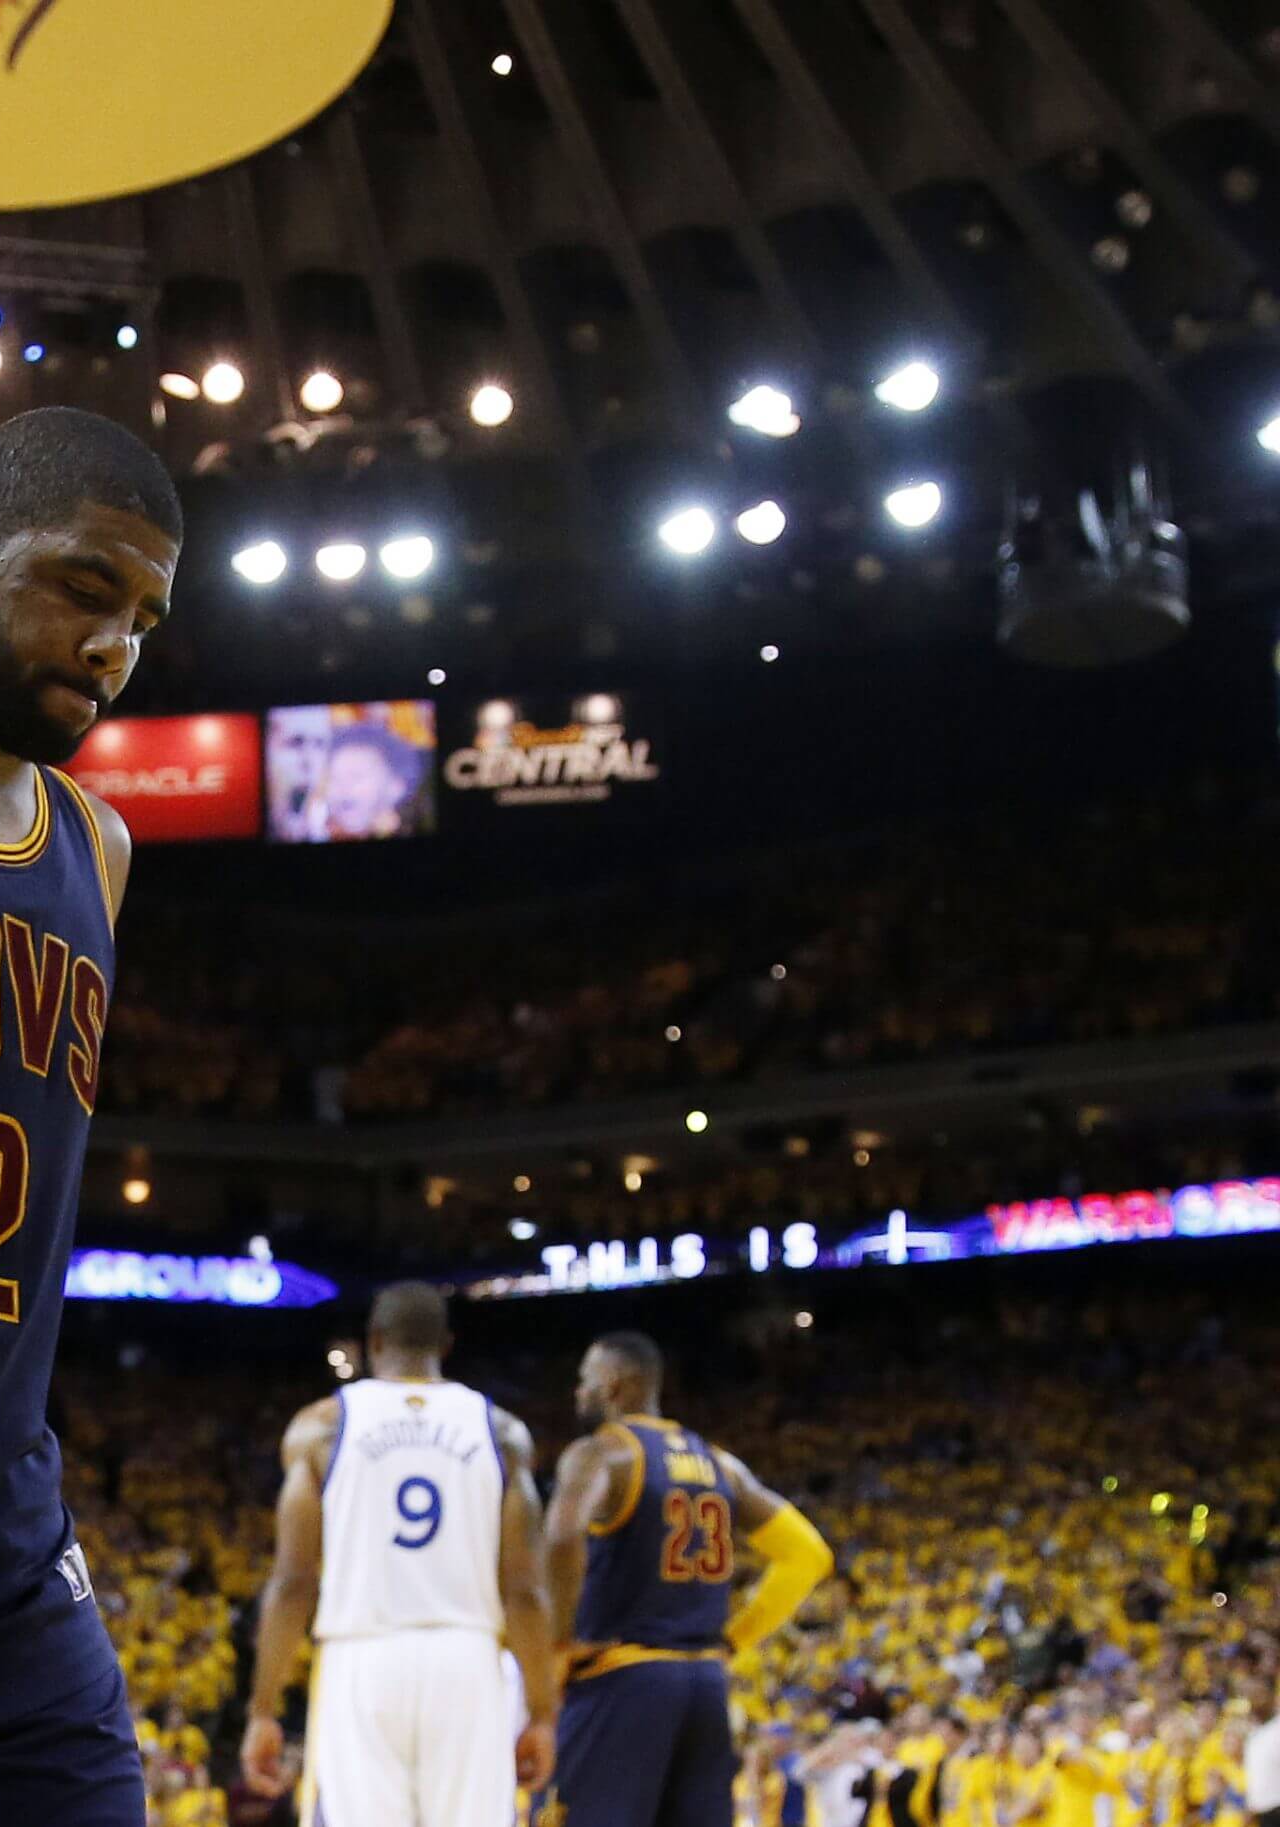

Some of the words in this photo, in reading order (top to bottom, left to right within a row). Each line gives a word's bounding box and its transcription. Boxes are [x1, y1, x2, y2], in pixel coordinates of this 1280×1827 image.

[444, 737, 660, 790] CENTRAL
[542, 1233, 707, 1292] THIS
[748, 1222, 819, 1273] IS
[393, 1476, 442, 1549] 9
[660, 1487, 735, 1583] 23
